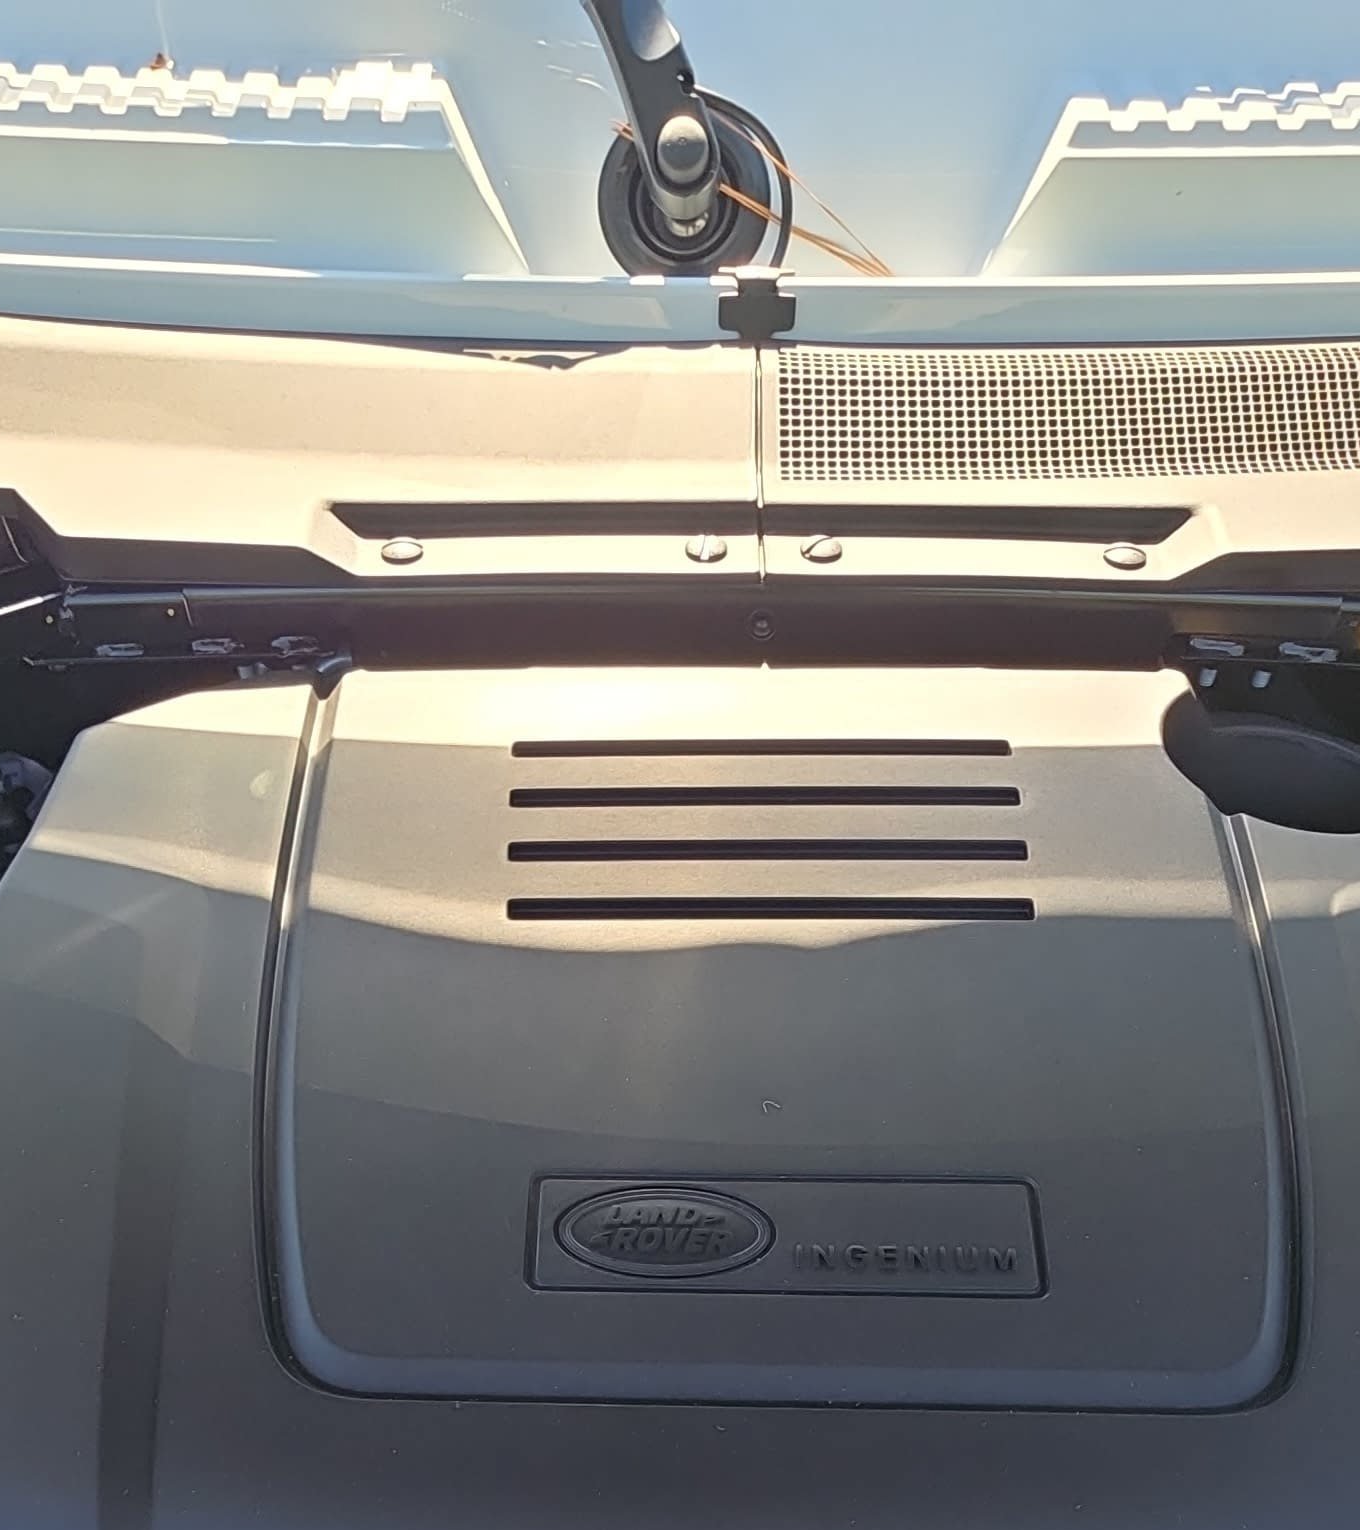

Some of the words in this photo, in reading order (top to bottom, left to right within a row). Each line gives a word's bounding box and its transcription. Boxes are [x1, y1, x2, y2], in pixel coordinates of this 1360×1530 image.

[602, 1204, 701, 1226] LAND
[609, 1227, 733, 1253] ROVER
[794, 1244, 1018, 1272] INGENIUM
